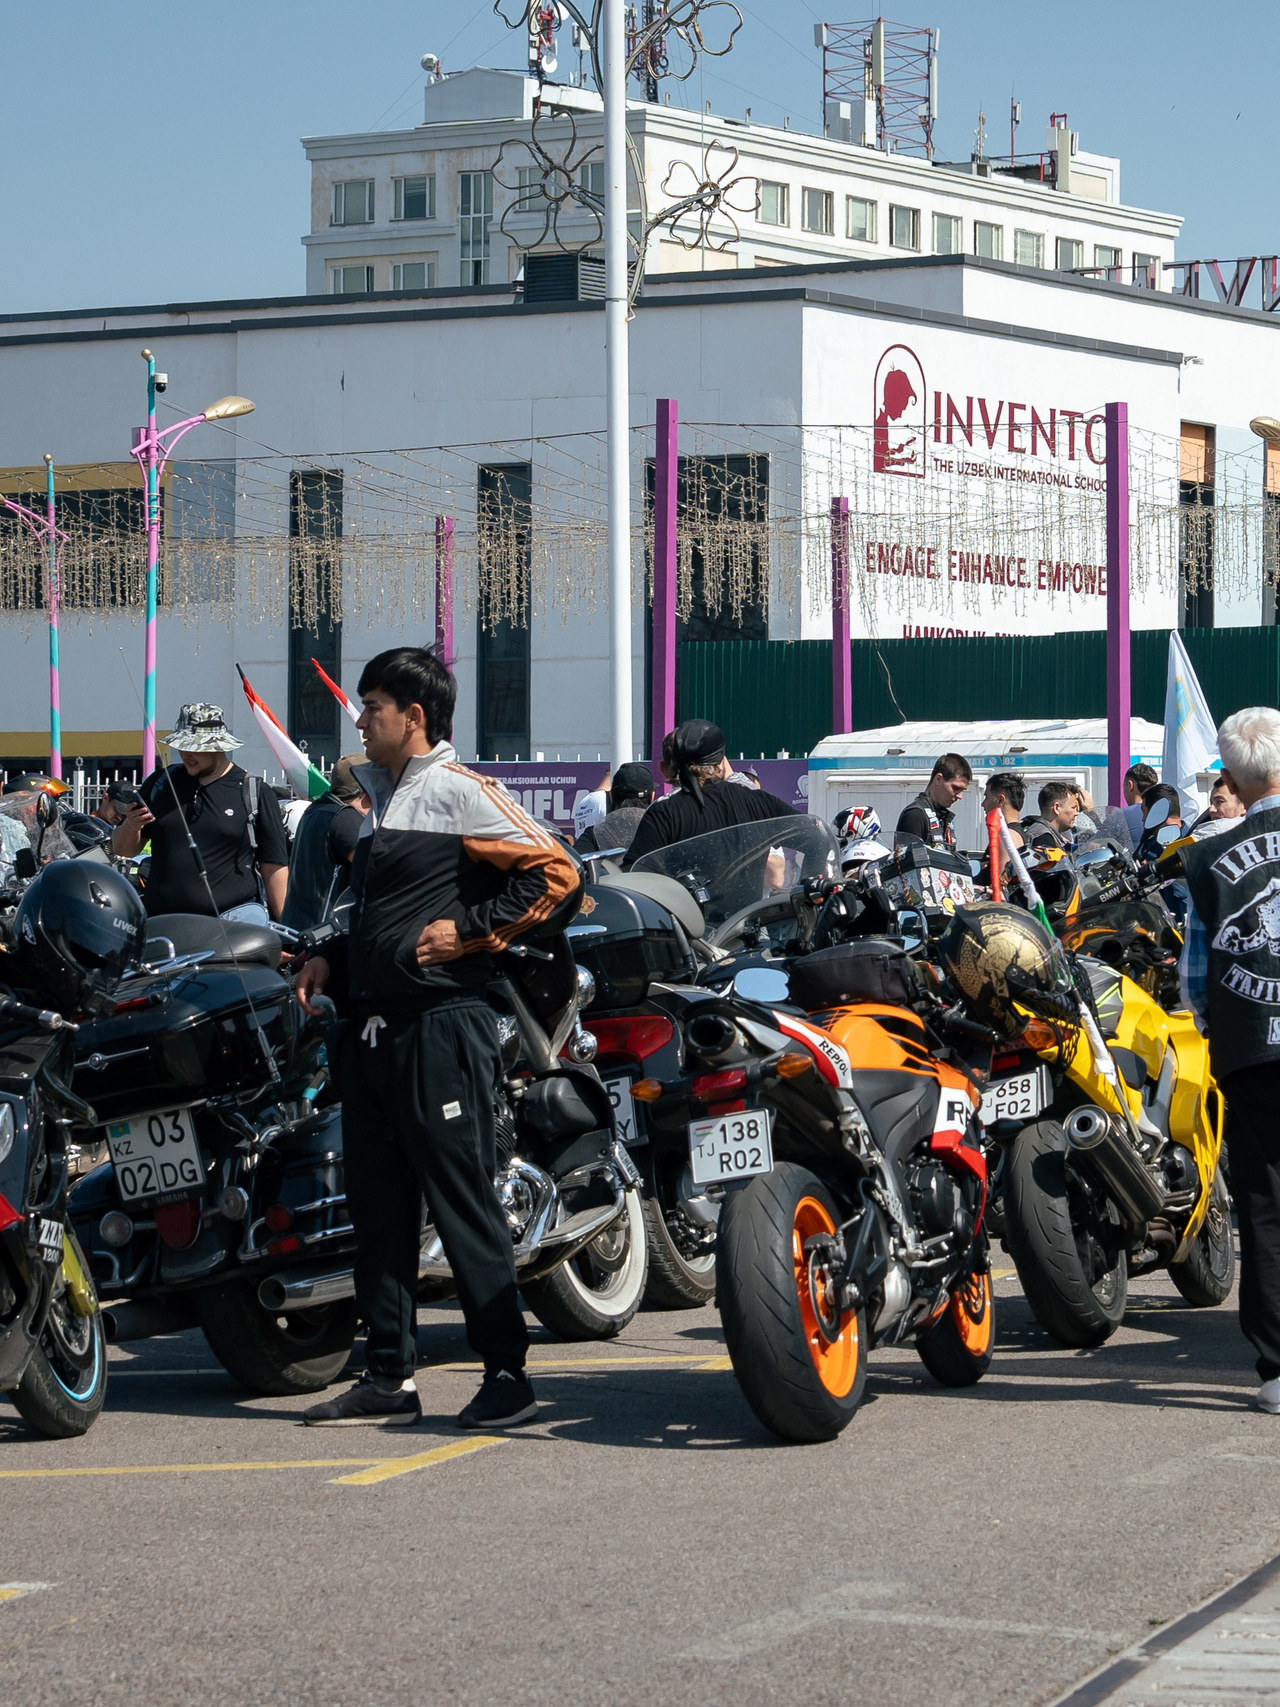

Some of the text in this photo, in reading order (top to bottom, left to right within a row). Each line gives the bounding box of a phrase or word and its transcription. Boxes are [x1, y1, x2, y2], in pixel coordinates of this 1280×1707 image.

[934, 458, 1107, 492] THE UZBEK INTERNATIONAL SCHOO
[1038, 559, 1107, 596] EMPOWE
[550, 776, 577, 785] UCHUN
[1099, 886, 1120, 903] BMW
[112, 917, 138, 937] uvex
[818, 1039, 848, 1077] REPSOL
[996, 1078, 1031, 1098] 658
[995, 1099, 1031, 1118] F02
[147, 1109, 185, 1148] 03
[719, 1119, 760, 1145] 138
[113, 1141, 134, 1158] KZ
[697, 1142, 716, 1159] TJ
[719, 1147, 763, 1174] R02
[120, 1158, 199, 1196] 02 DG
[155, 1191, 189, 1204] YAMAHA
